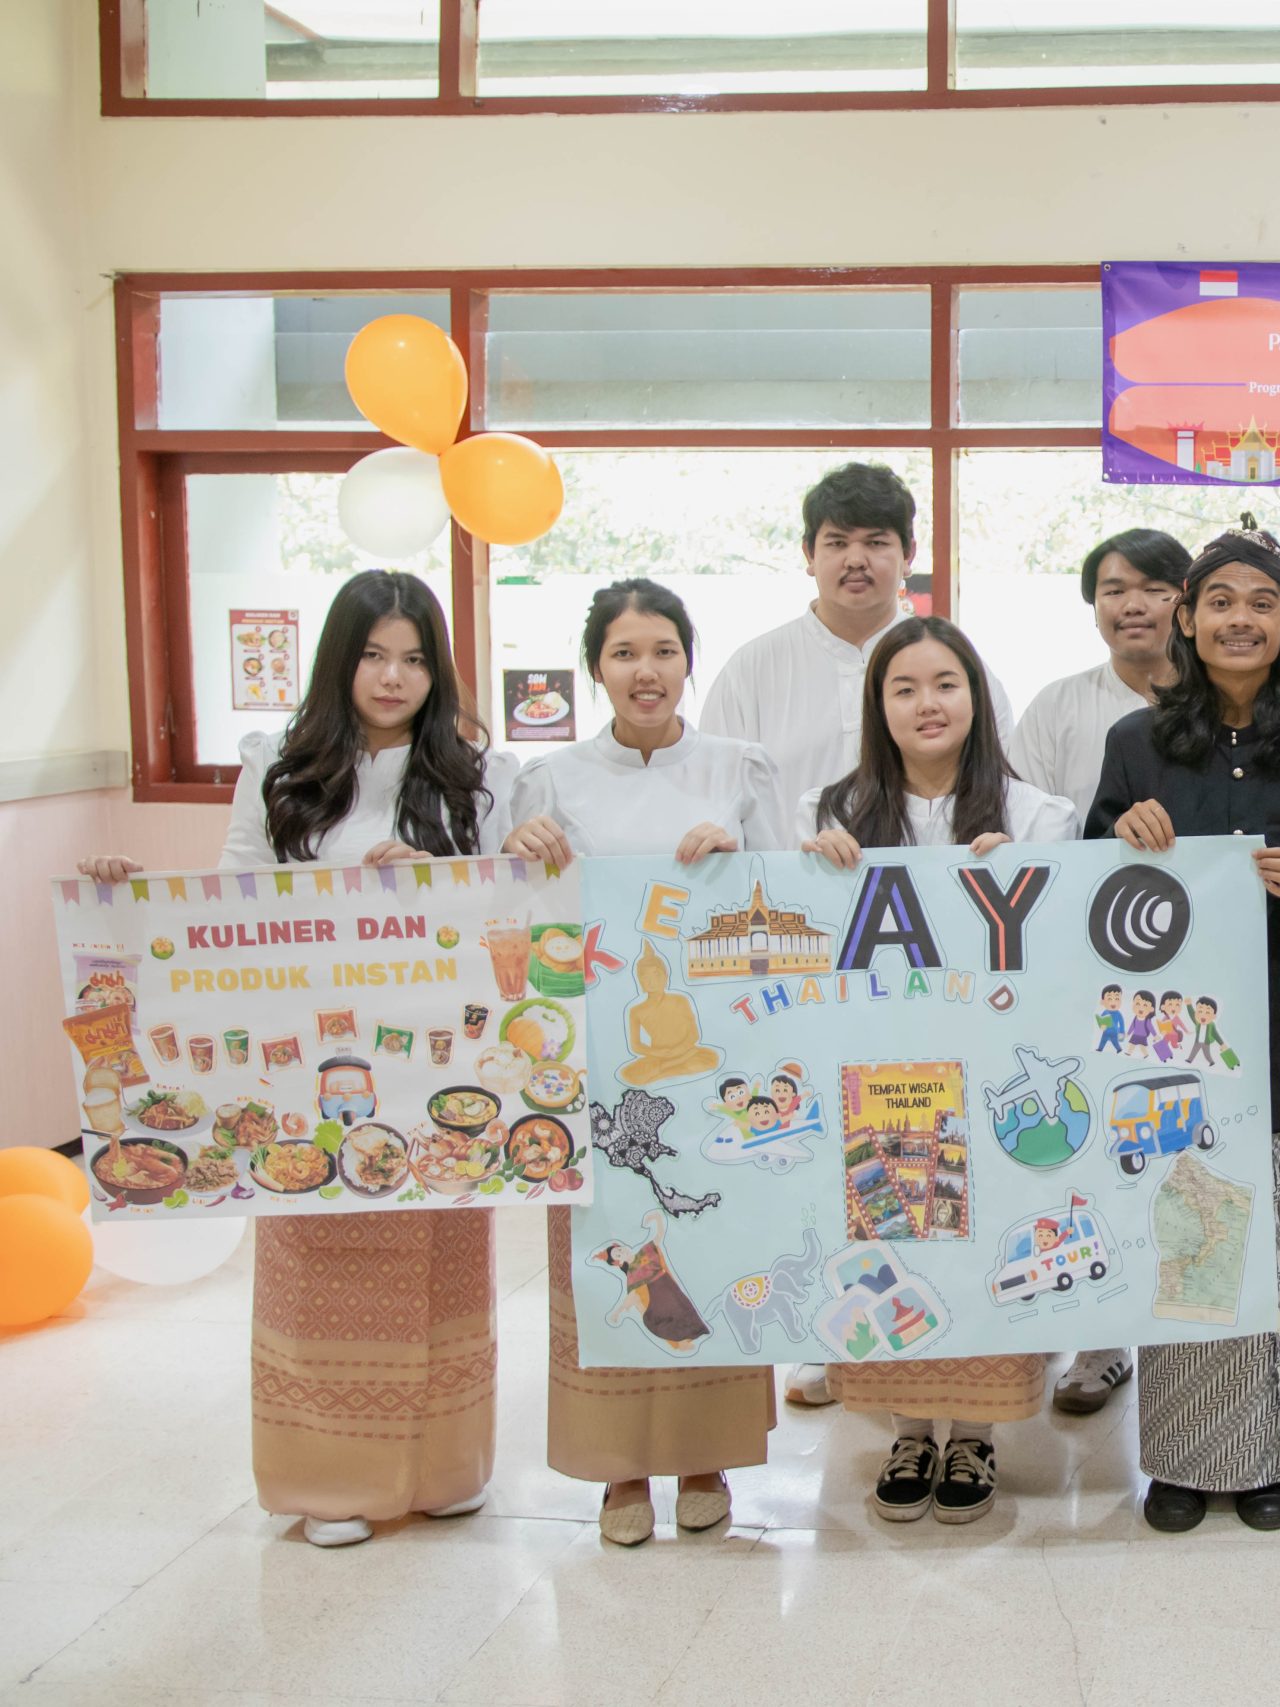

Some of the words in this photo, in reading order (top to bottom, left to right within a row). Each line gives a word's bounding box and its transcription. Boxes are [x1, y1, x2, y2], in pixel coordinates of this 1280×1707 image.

[187, 918, 336, 949] KULINER
[357, 916, 427, 941] DAN
[836, 863, 1191, 973] AYO
[170, 963, 311, 994] PRODUK
[333, 957, 458, 988] INSTAN
[732, 970, 1015, 1025] THAILAND
[868, 1084, 908, 1097] TEMPAT
[909, 1082, 945, 1095] WISATA
[885, 1096, 932, 1109] THAILAND
[1041, 1241, 1100, 1272] TOUR!
